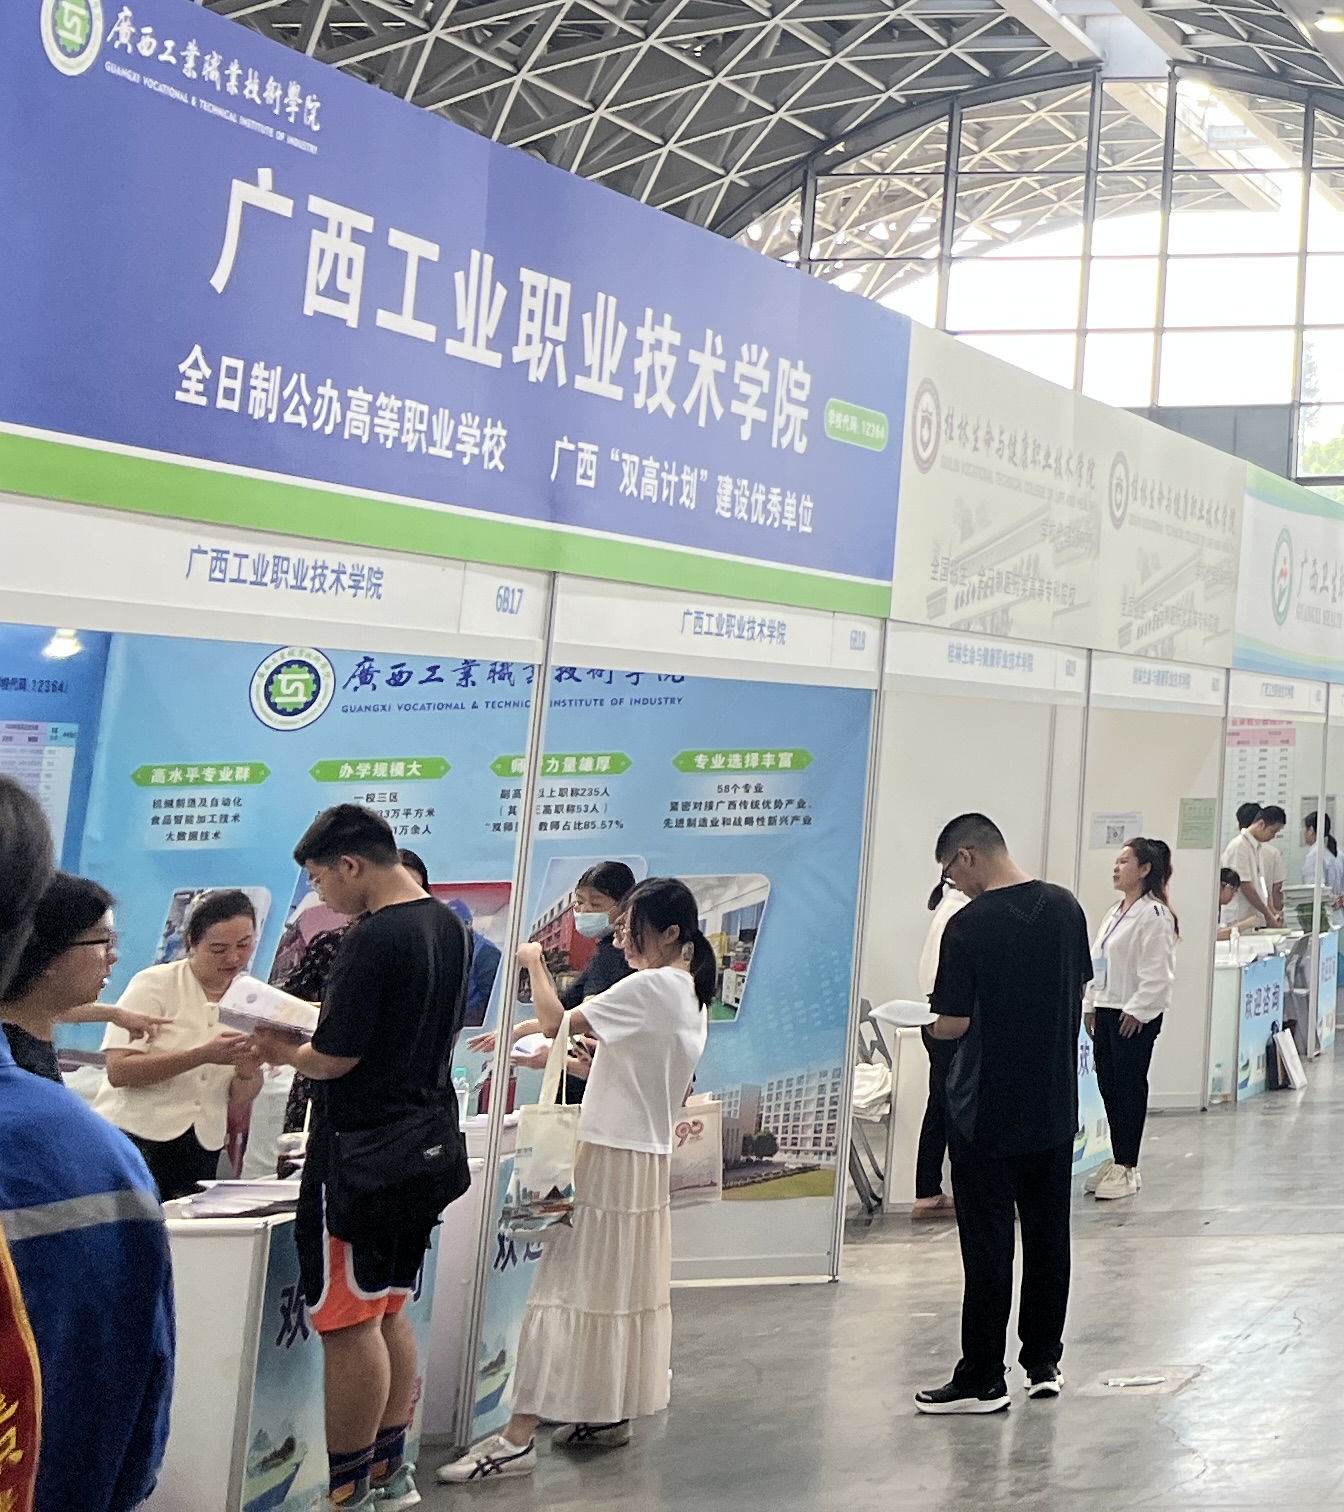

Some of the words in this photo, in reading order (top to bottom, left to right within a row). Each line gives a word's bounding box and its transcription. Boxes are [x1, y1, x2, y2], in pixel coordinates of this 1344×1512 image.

[104, 60, 141, 85] GUANGXI
[143, 75, 189, 104] VOCATIONAL
[199, 98, 238, 123] TECHNICAL
[239, 115, 274, 139] INSTITUTE
[275, 129, 285, 141] OF
[287, 133, 318, 155] INDUSTRY
[210, 168, 812, 454] 广西工业职业技术学院
[174, 344, 508, 473] 全日制公办高等职业学校
[945, 407, 1096, 490] 桂林生命与健康职业技术学院
[186, 544, 385, 601] 广西工业职业技术学院
[496, 585, 524, 615] 6B17
[681, 608, 787, 646] 广西工业职业技术学院
[341, 702, 391, 714] GUANGXI
[397, 701, 465, 713] VOCATIONAL
[471, 700, 478, 710] &
[485, 698, 530, 710] TECHNIC
[549, 696, 604, 709] INSTITUTE
[611, 696, 624, 707] OF
[629, 695, 684, 707] INDUSTRY
[150, 766, 251, 785] 高水平专业群
[338, 761, 422, 779] 办学规模大
[511, 756, 611, 775] 师力量雄厚
[694, 752, 794, 770] 专业选择丰富
[717, 783, 764, 795] 58个专业
[1245, 990, 1282, 1020] 欢迎咨询
